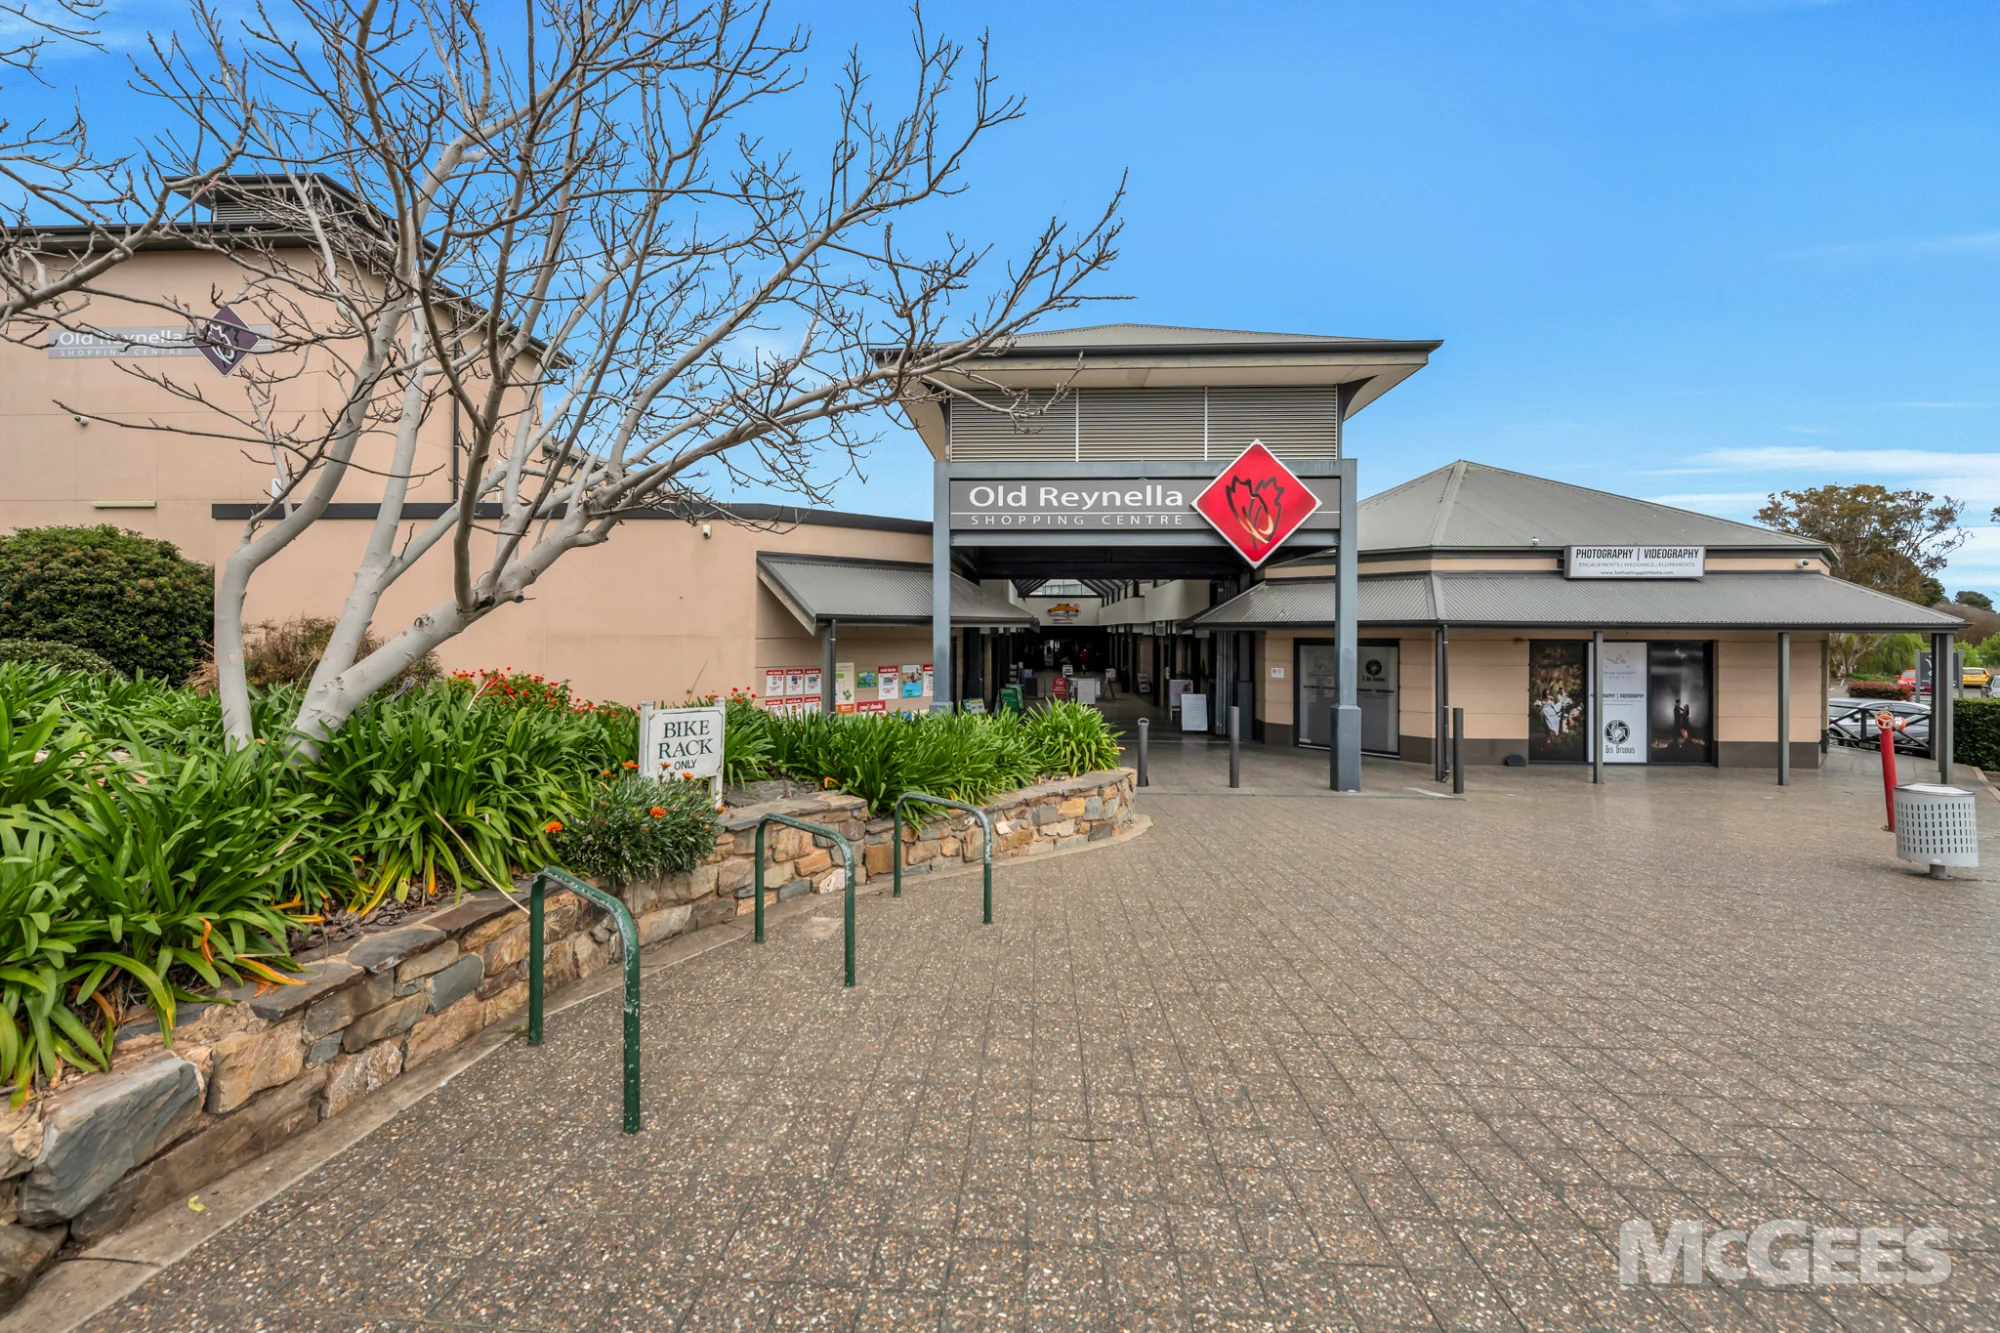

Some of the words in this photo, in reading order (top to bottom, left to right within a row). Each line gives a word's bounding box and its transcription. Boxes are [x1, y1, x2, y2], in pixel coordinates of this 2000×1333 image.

[134, 348, 183, 356] CENTRE
[969, 485, 1027, 507] Old
[1039, 485, 1183, 510] Reynella
[971, 515, 1084, 525] SHOPPING
[1101, 515, 1182, 525] CENTRE
[1576, 548, 1634, 559] PHOTOGRAPHY
[1644, 548, 1700, 559] VIDEOGRAPHY
[870, 702, 883, 710] deals
[663, 719, 711, 739] BIKE
[658, 738, 714, 760] RACK
[674, 758, 698, 771] ONLY
